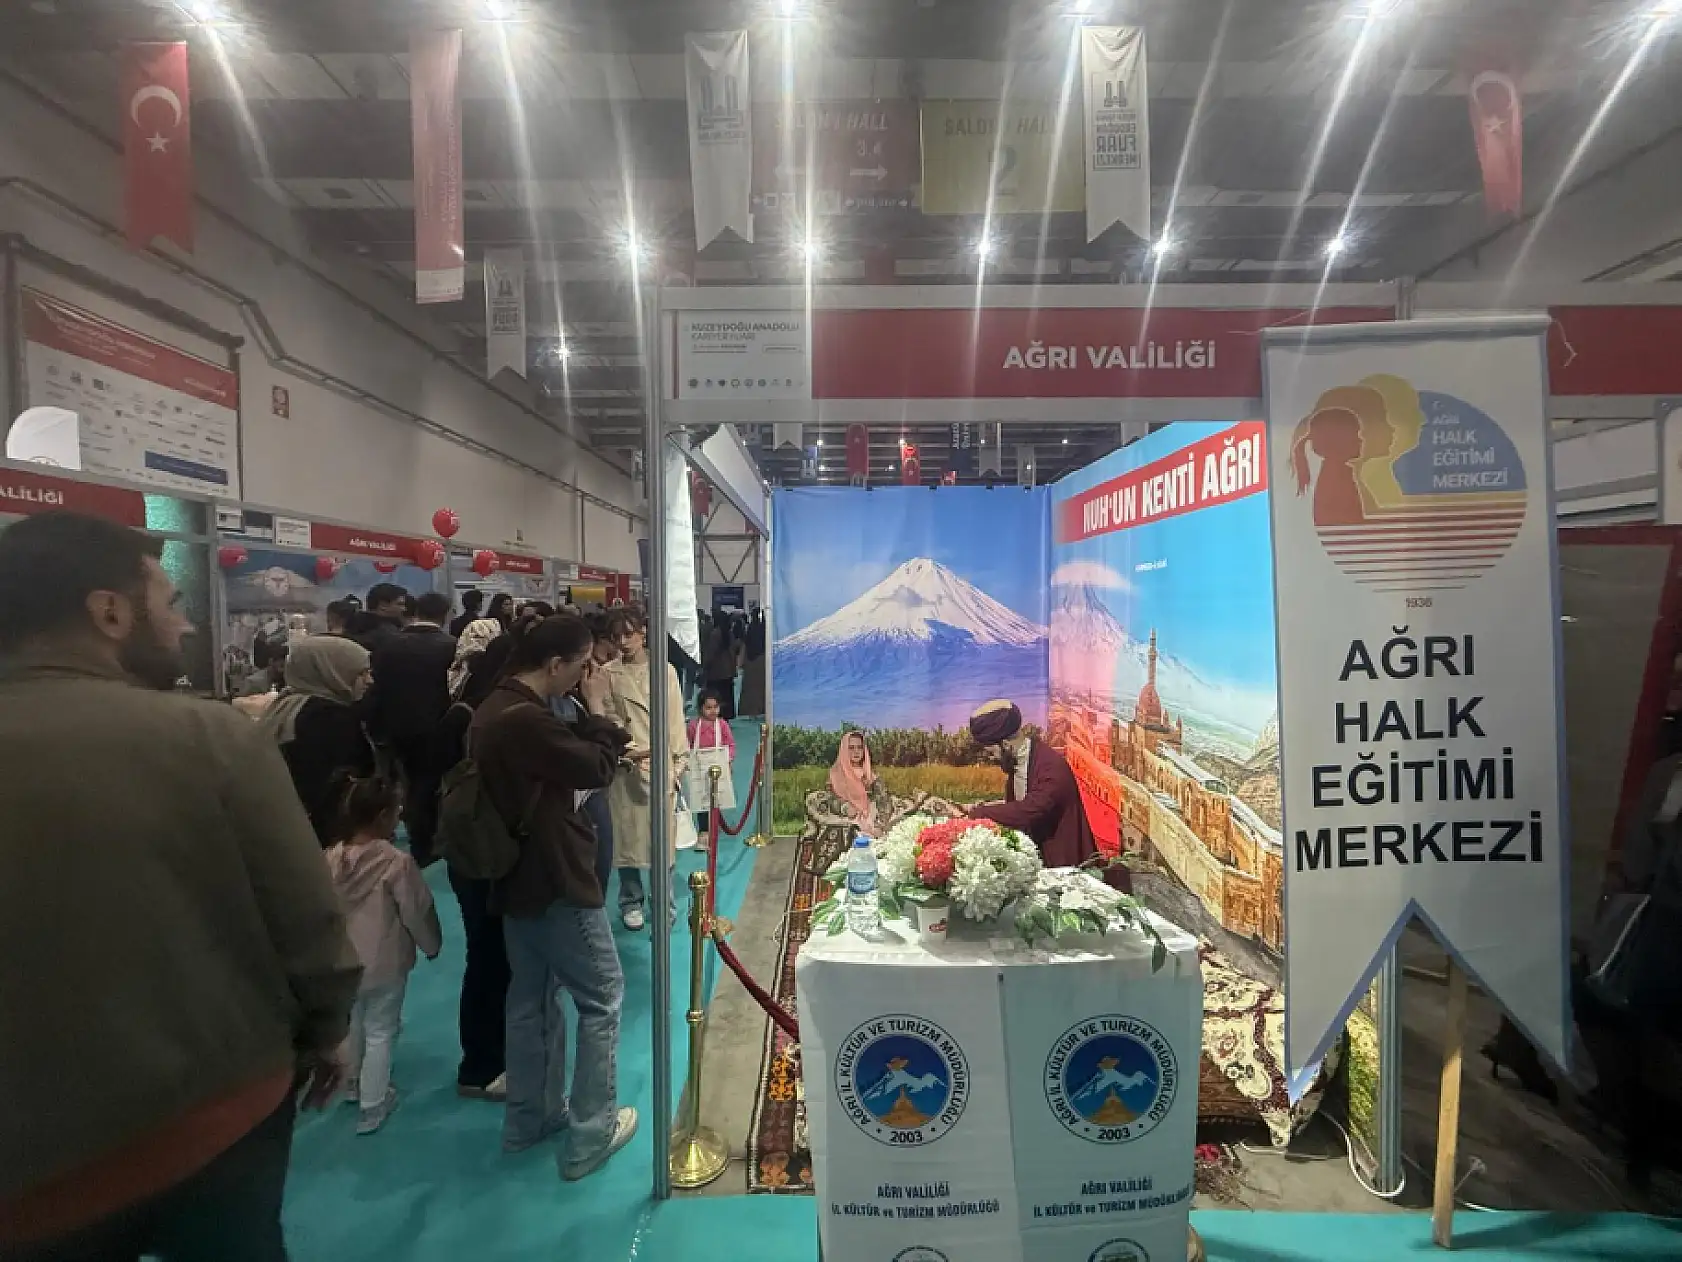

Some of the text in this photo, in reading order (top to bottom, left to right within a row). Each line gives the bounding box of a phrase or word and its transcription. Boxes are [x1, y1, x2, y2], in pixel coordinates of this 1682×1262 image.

[1002, 339, 1216, 369] AĞRI VALİLİĞİ
[1432, 429, 1478, 445] HALK
[1433, 446, 1495, 467] EĞİTİMİ
[1083, 433, 1260, 534] NUH'UN KENTİ AĞRI
[1433, 467, 1509, 489] MERKEZİ
[1338, 625, 1475, 681] AĞRI
[1335, 696, 1487, 744] HALK
[1312, 747, 1515, 808] EĞİTİMİ
[1295, 811, 1543, 872] MERKEZİ
[868, 1022, 887, 1037] VE
[888, 1019, 942, 1042] TURİZM
[1079, 1022, 1098, 1037] VE
[1100, 1019, 1153, 1042] TURİZM
[840, 1031, 869, 1077] KÜLTÜR
[1048, 1033, 1080, 1079] KÜLTÜR
[939, 1040, 966, 1125] MÜDÜRLÜĞÜ
[1147, 1039, 1174, 1121] MÜDÜRLÜĞÜ
[844, 1095, 872, 1125] AĞRI
[1053, 1097, 1081, 1125] AĞRI
[890, 1130, 924, 1144] 2003
[1097, 1127, 1131, 1141] 2003
[877, 1180, 951, 1199] AĞRI VALİLİĞİ
[1081, 1176, 1153, 1195] AĞRI VALİLİĞİ
[843, 1200, 881, 1217] KÜLTÜR
[883, 1207, 895, 1218] ve
[896, 1204, 935, 1219] TURİZM
[937, 1198, 1000, 1217] MÜDÜRLÜĞÜ
[1044, 1201, 1083, 1217] KÜLTÜR
[1098, 1198, 1136, 1213] TURİZM
